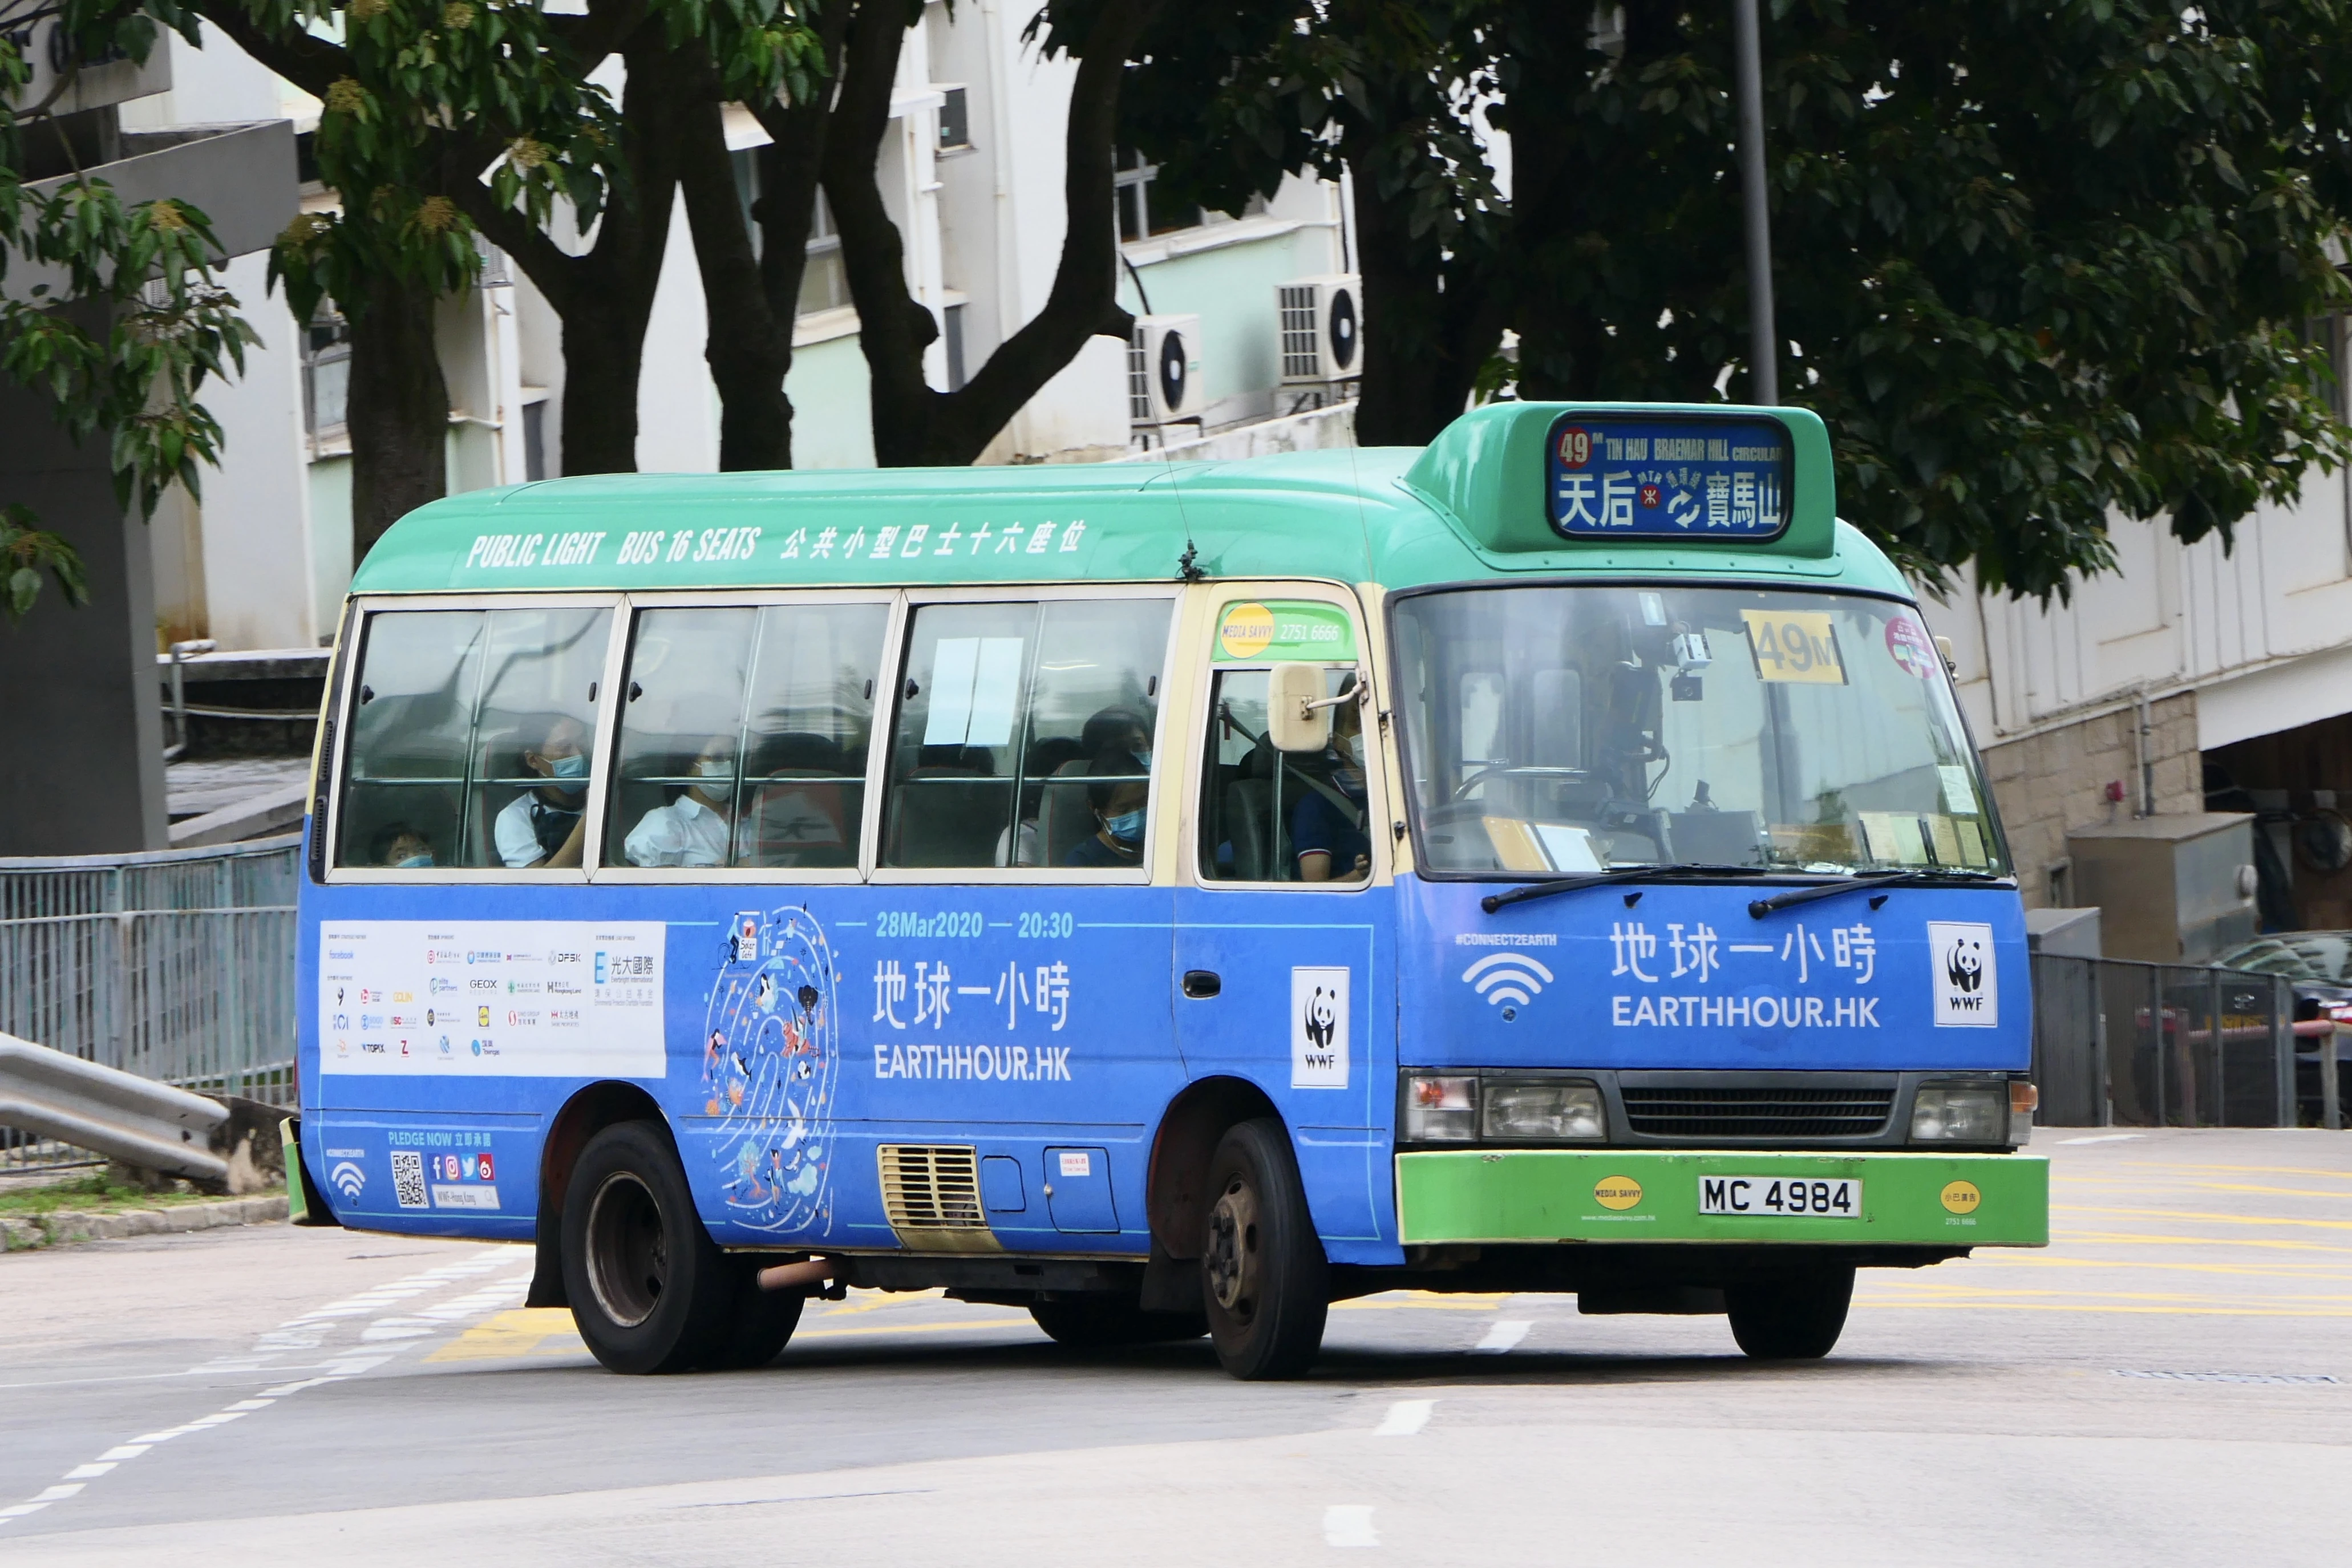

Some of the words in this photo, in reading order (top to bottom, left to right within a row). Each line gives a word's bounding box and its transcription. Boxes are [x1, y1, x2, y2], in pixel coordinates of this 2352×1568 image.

[1606, 438, 1623, 460] TIN
[1625, 438, 1648, 461] HAU
[1654, 438, 1705, 461] BRAEMAR
[1707, 439, 1729, 461] HILL
[1732, 447, 1783, 461] CIRCULAR
[1637, 470, 1662, 485] MTR
[1558, 469, 1637, 527] 天后
[1706, 471, 1781, 528] 寶馬山
[465, 533, 544, 568] PUBLIC
[541, 531, 607, 566] LIGHT
[616, 530, 665, 565] BUS
[665, 529, 690, 563] 16
[693, 526, 762, 562] SEATS
[780, 520, 1086, 560] 公共小型巴士十六座位
[1222, 625, 1246, 638] MEDIA
[1248, 625, 1273, 638] SAVVY
[1280, 624, 1307, 640] 2751
[1311, 625, 1339, 641] 6666
[1756, 621, 1840, 672] 49M
[876, 911, 983, 938] 28Mar2020
[1018, 912, 1073, 939] 20:30
[1455, 933, 1557, 947] #CONNECT2EARTH
[329, 950, 354, 959] facebook
[558, 954, 581, 963] DFSK
[1609, 922, 1877, 984] 地球一小時
[612, 956, 654, 975] 光大國際
[469, 979, 497, 989] GEOX
[873, 960, 1070, 1032] 地球一小時
[1950, 997, 1983, 1011] WWF
[1612, 996, 1881, 1028] EARTHHOUR.HK
[874, 1044, 1072, 1082] EARTHHOUR.HK
[1305, 1054, 1335, 1069] WWF
[388, 1131, 425, 1146] PLEDGE
[427, 1132, 452, 1146] NOW
[455, 1132, 491, 1147] 立即承諾
[1595, 1189, 1616, 1198] MEDIA
[1619, 1189, 1641, 1198] SAVVY
[1705, 1179, 1751, 1211] MC
[1765, 1181, 1851, 1213] 4984
[1945, 1193, 1976, 1202] 小巴廣告
